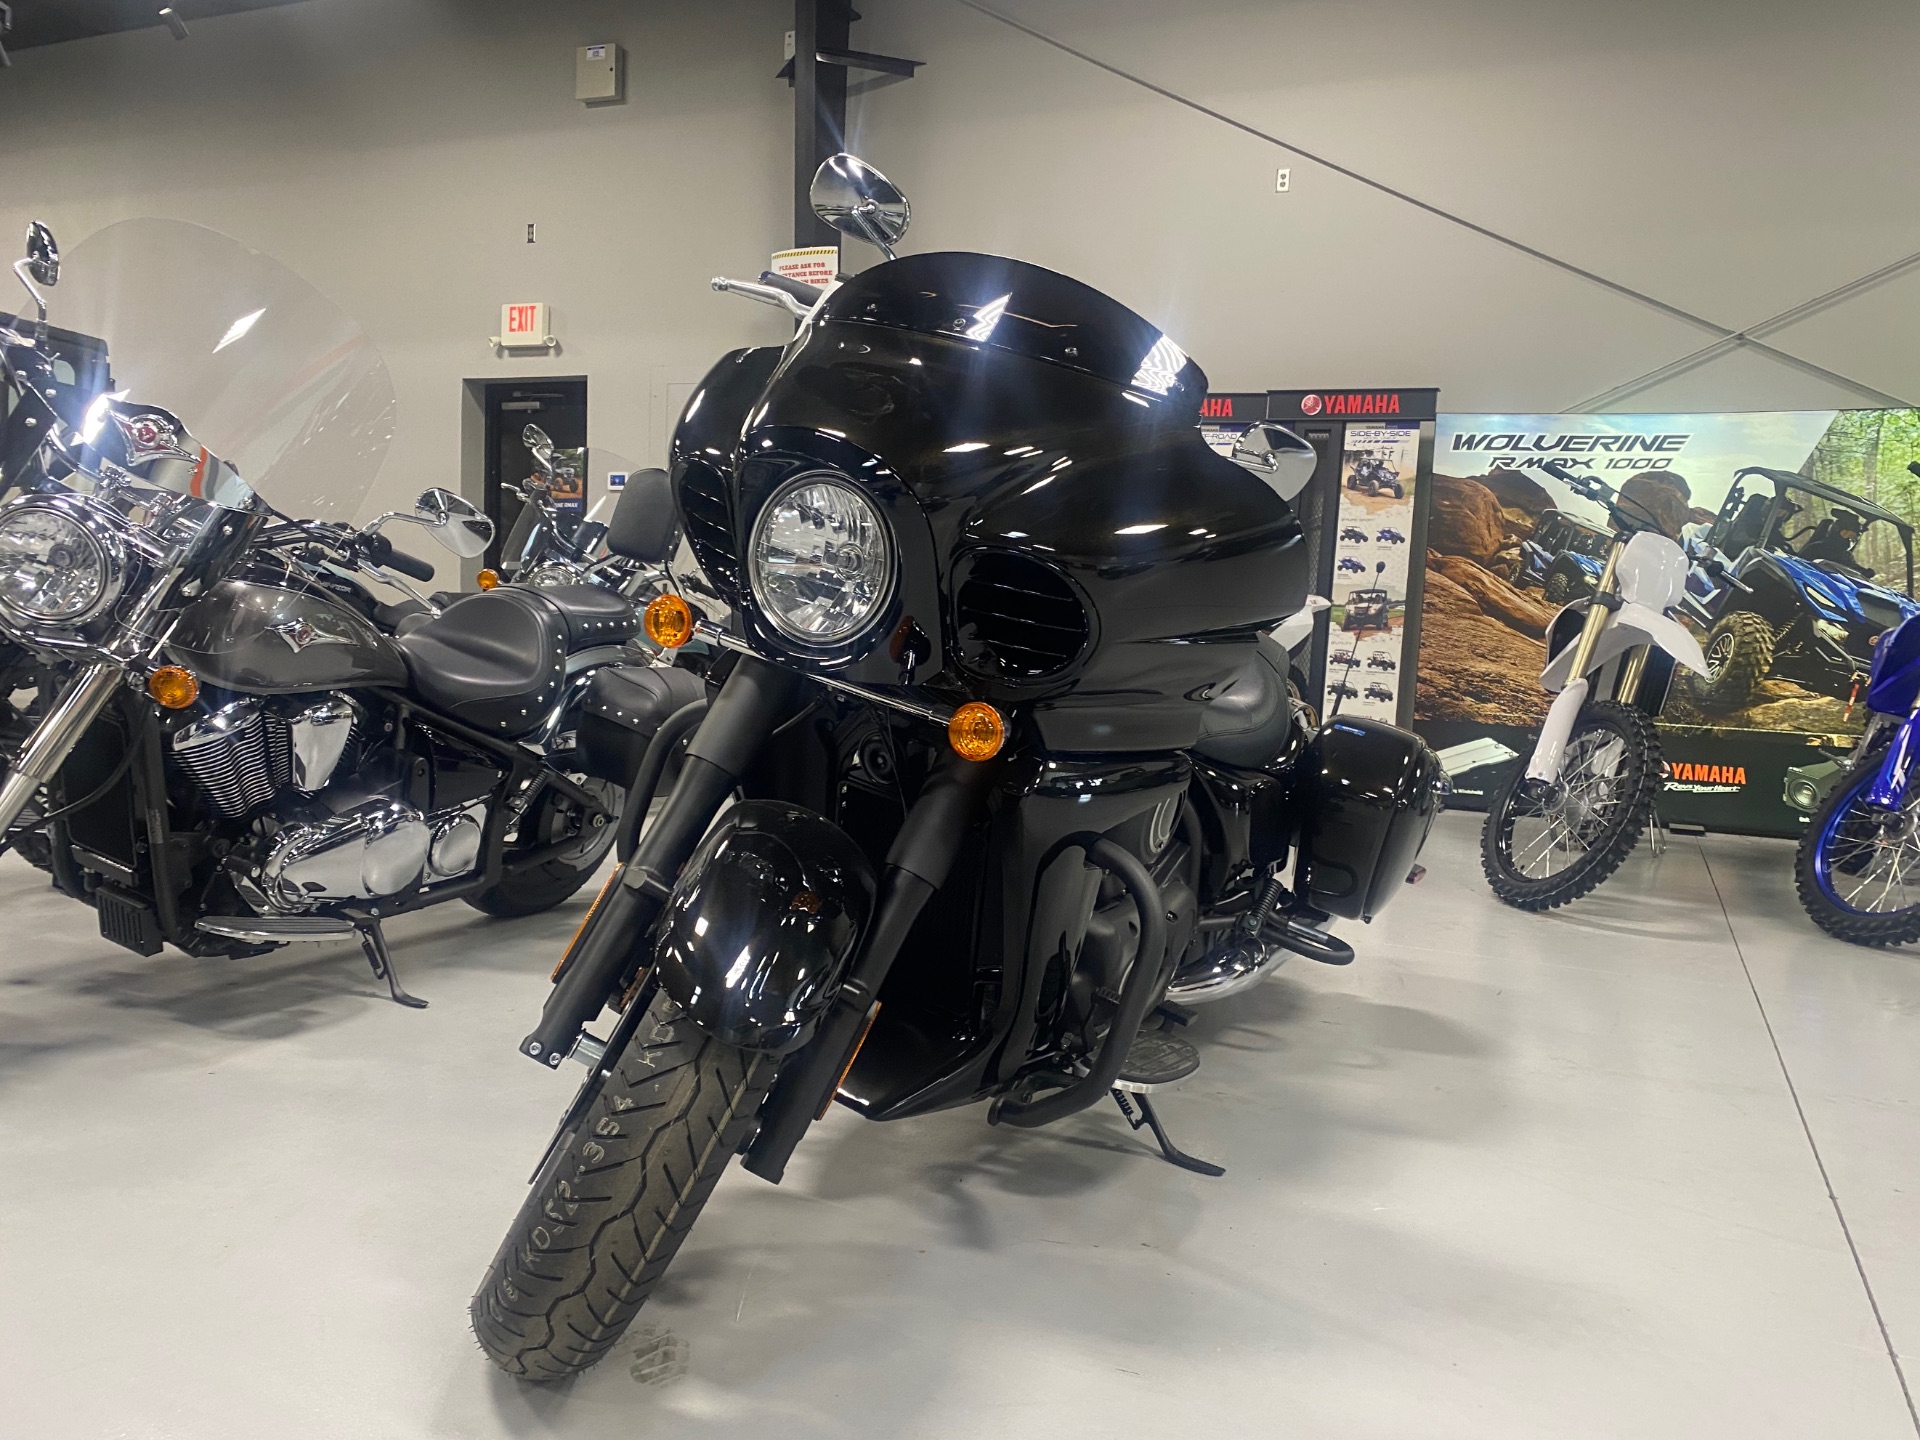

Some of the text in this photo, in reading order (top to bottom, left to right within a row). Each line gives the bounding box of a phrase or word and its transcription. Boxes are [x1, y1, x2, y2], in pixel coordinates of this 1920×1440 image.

[509, 305, 537, 333] EXIT
[1199, 398, 1233, 417] AHA
[1324, 394, 1400, 414] YAMAHA
[1451, 433, 1692, 452] WOLVERINE
[1488, 456, 1675, 470] RMAX 1000
[1671, 762, 1747, 785] YAMAHA
